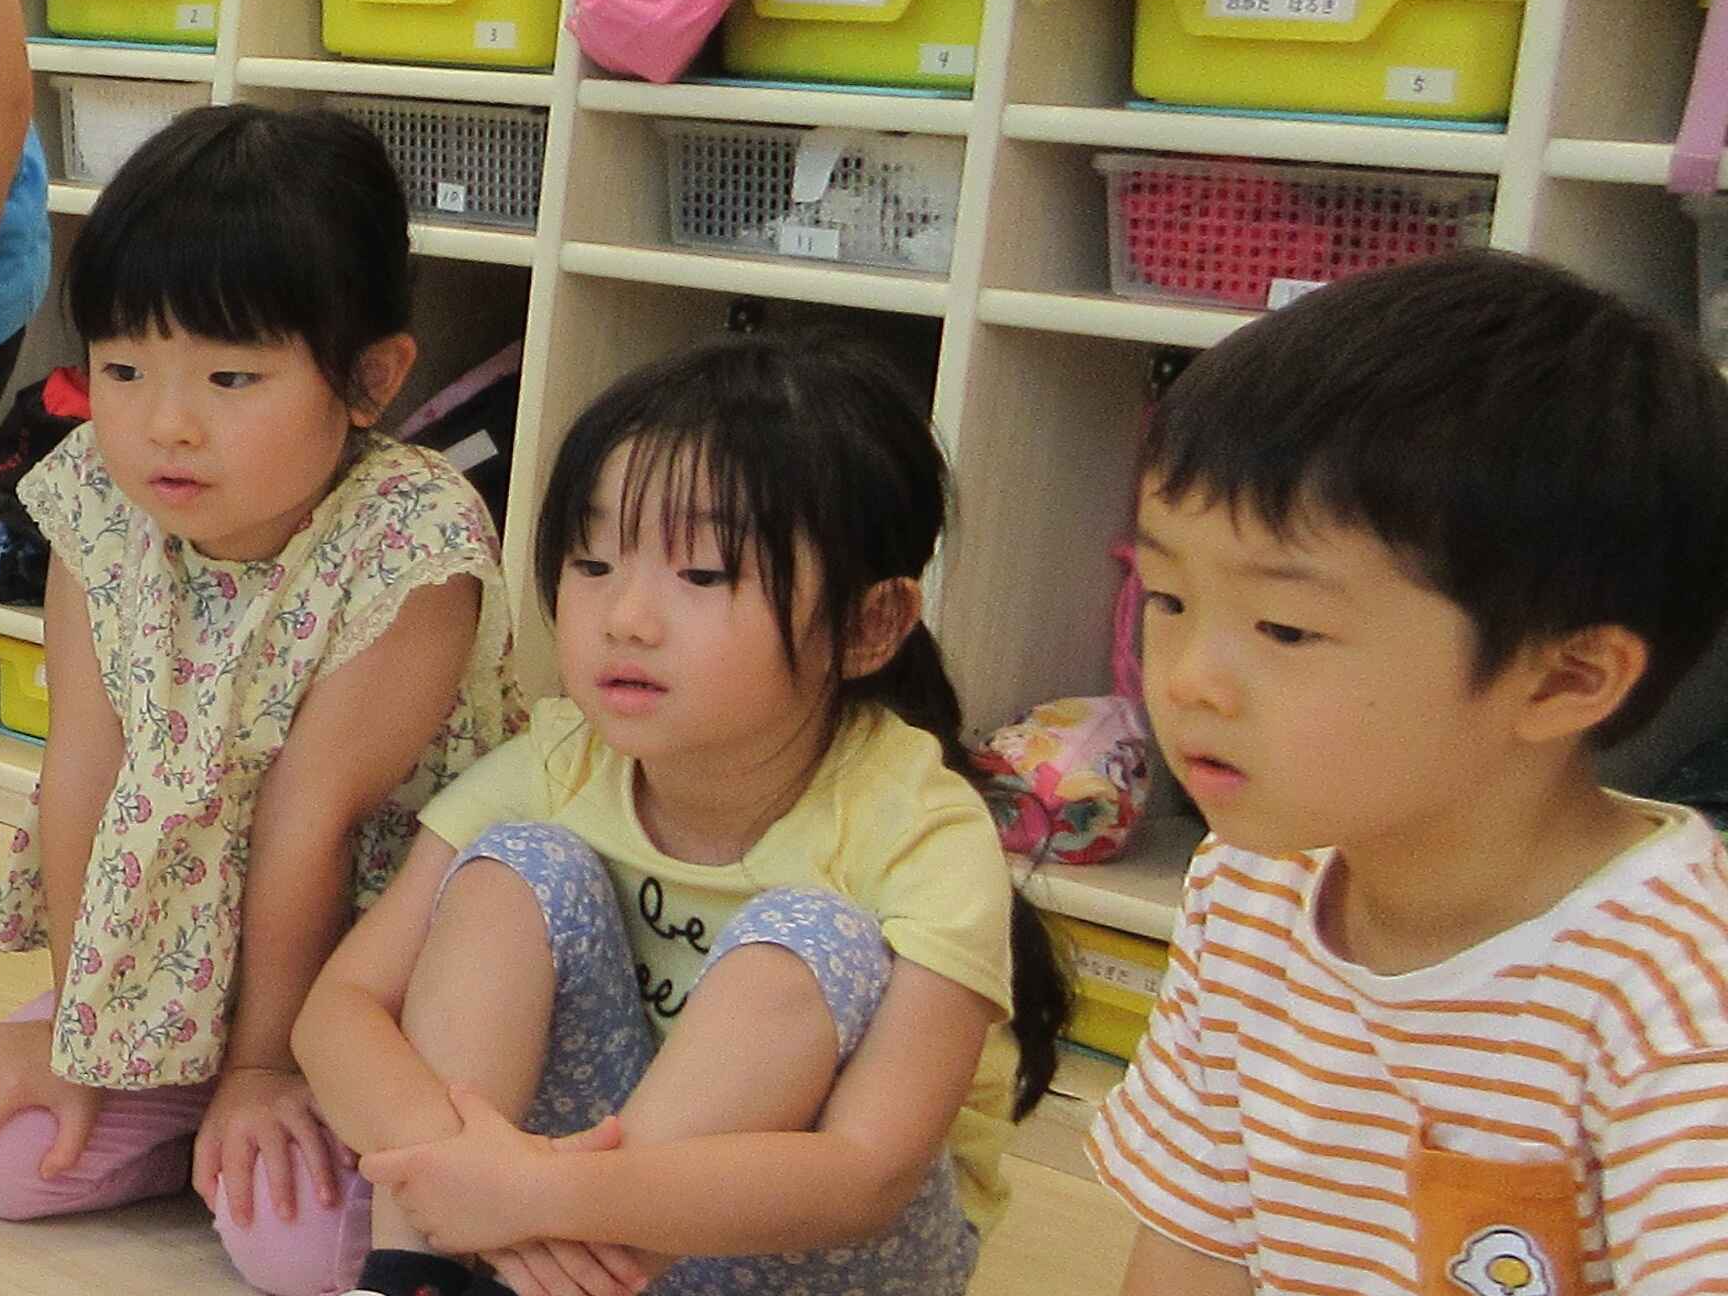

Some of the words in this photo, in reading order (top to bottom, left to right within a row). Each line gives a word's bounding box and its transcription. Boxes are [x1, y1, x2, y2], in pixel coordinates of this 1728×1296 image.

[189, 8, 199, 24] 2
[488, 27, 498, 43] 3
[1412, 75, 1425, 93] 5
